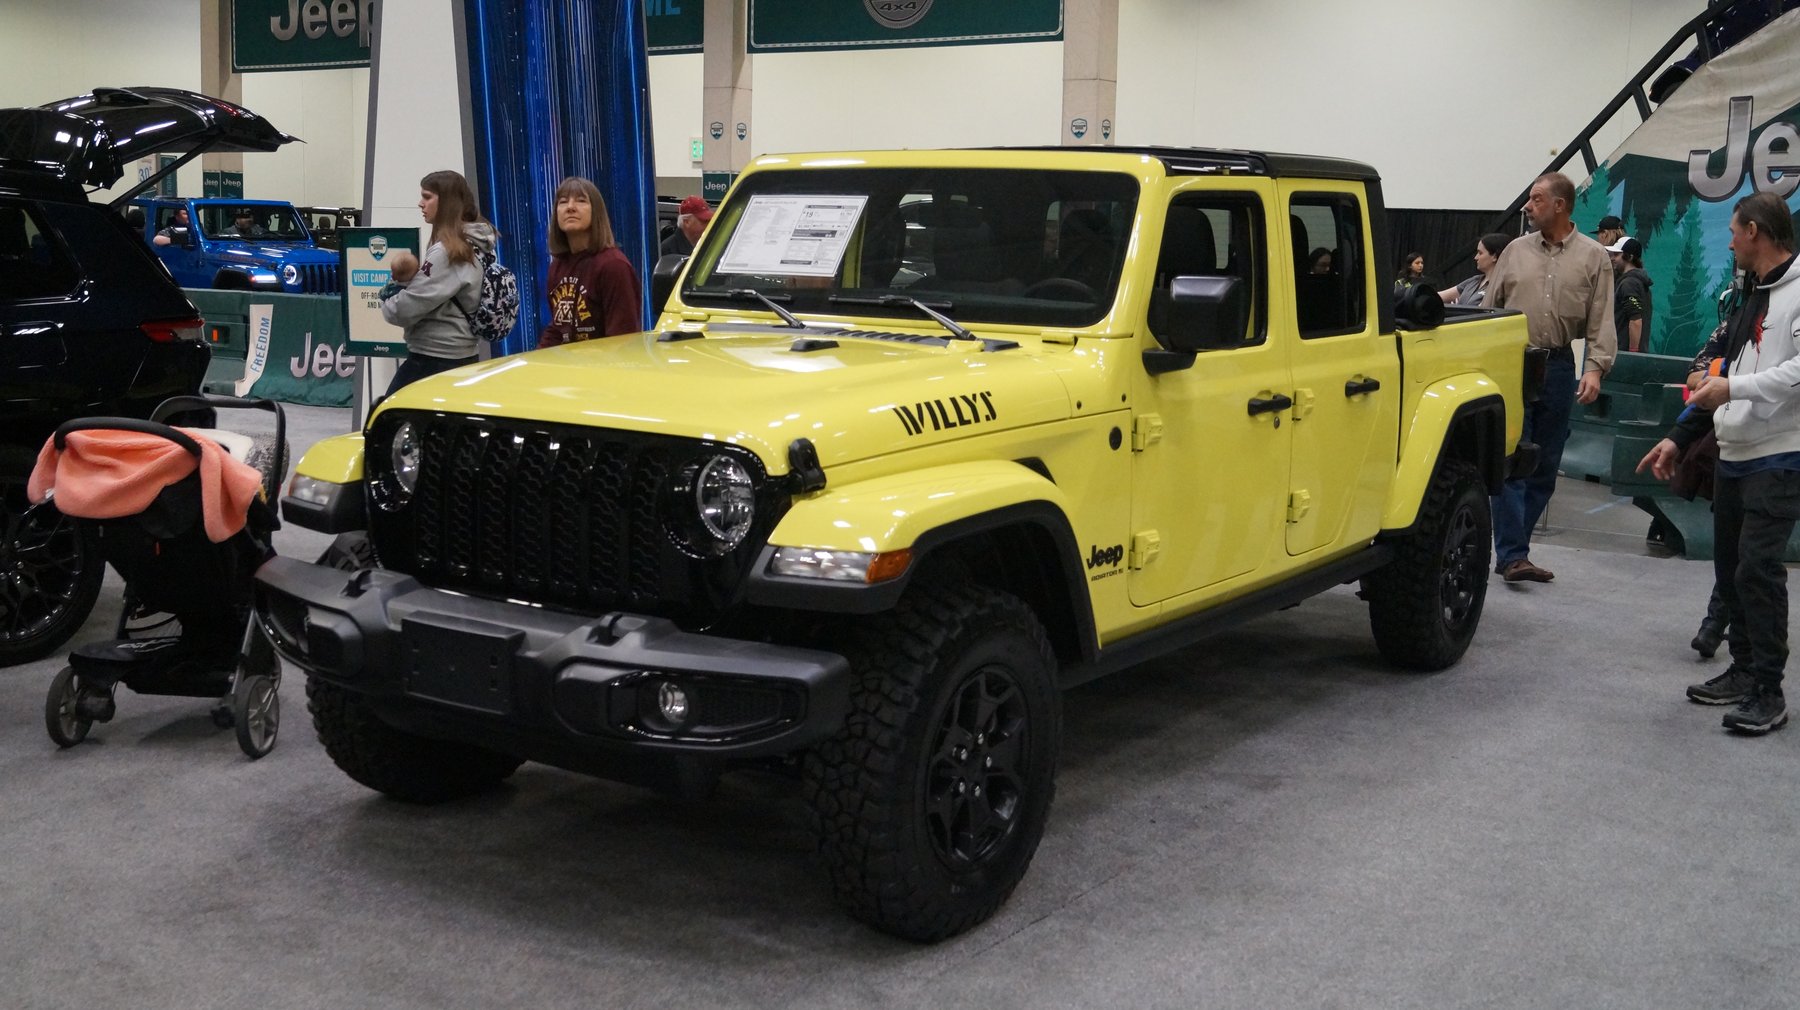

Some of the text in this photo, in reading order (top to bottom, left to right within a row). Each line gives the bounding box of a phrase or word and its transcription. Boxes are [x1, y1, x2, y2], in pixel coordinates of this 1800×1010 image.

[879, 1, 917, 11] 4x4
[1688, 95, 1800, 203] Je
[222, 179, 242, 188] Jeep
[704, 181, 728, 193] Jeep
[353, 273, 389, 284] VISIT CAMP
[250, 316, 271, 373] FREEDOM
[374, 344, 389, 353] Jeep
[290, 331, 356, 378] Jee
[892, 390, 997, 436] WILLYS
[1086, 544, 1124, 570] Jeep
